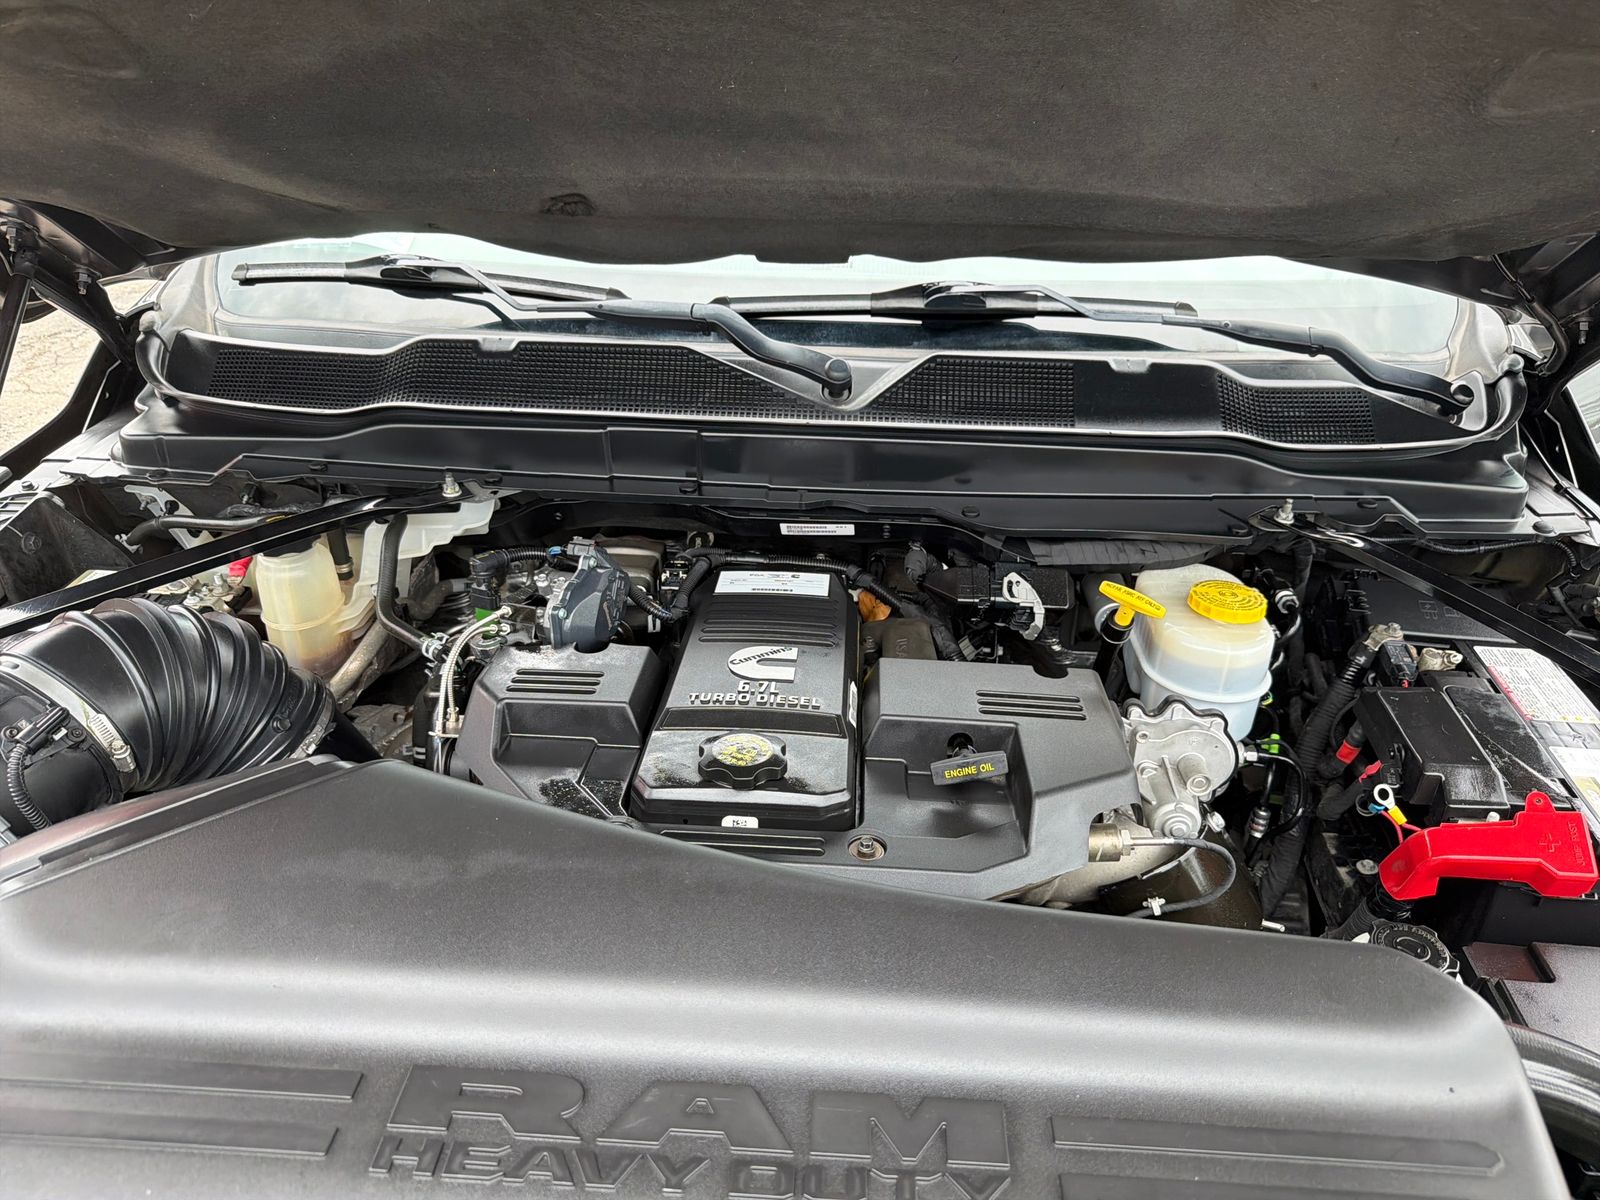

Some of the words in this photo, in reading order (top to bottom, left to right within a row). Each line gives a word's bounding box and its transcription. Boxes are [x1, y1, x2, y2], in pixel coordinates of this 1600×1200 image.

[729, 646, 793, 666] Cummins
[737, 680, 779, 695] 6.7L
[689, 692, 750, 706] TURBO
[756, 693, 821, 710] DIESEL
[944, 765, 978, 779] ENGINE
[979, 762, 995, 773] OIL
[387, 1064, 1011, 1170] RAM
[368, 1135, 711, 1197] HEAVY
